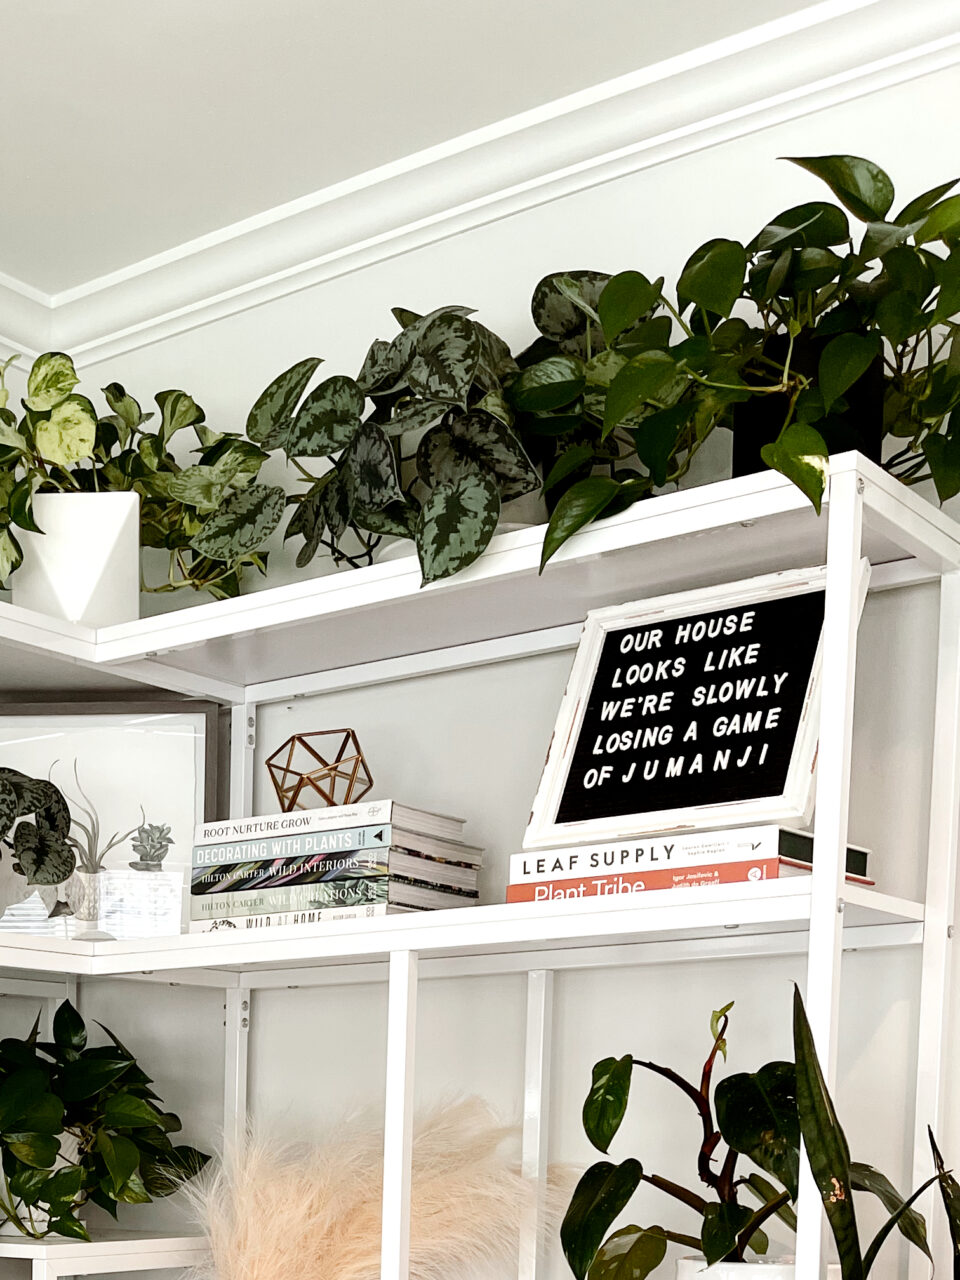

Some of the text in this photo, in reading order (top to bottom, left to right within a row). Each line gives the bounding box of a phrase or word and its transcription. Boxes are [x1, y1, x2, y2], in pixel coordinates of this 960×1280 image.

[620, 611, 756, 653] OUR HOUSE
[611, 643, 760, 688] LOOKS LIKE
[600, 672, 788, 721] WE'RE SLOWLY
[592, 707, 782, 755] LOSING A GAME
[583, 743, 769, 789] OF JUMANJI
[203, 825, 231, 839] ROOT
[232, 821, 279, 836] NURTURE
[280, 816, 312, 830] GROW
[196, 841, 267, 866] DECORATING
[271, 836, 302, 855] WITH
[305, 832, 353, 852] PLANTS
[523, 843, 675, 875] LEAF SUPPLY
[201, 869, 265, 884] HILTON CARTER
[269, 864, 297, 877] WILD
[300, 856, 359, 874] INTERIORS
[201, 898, 265, 912] HILTON CARTER
[534, 877, 645, 902] Plant Tribe
